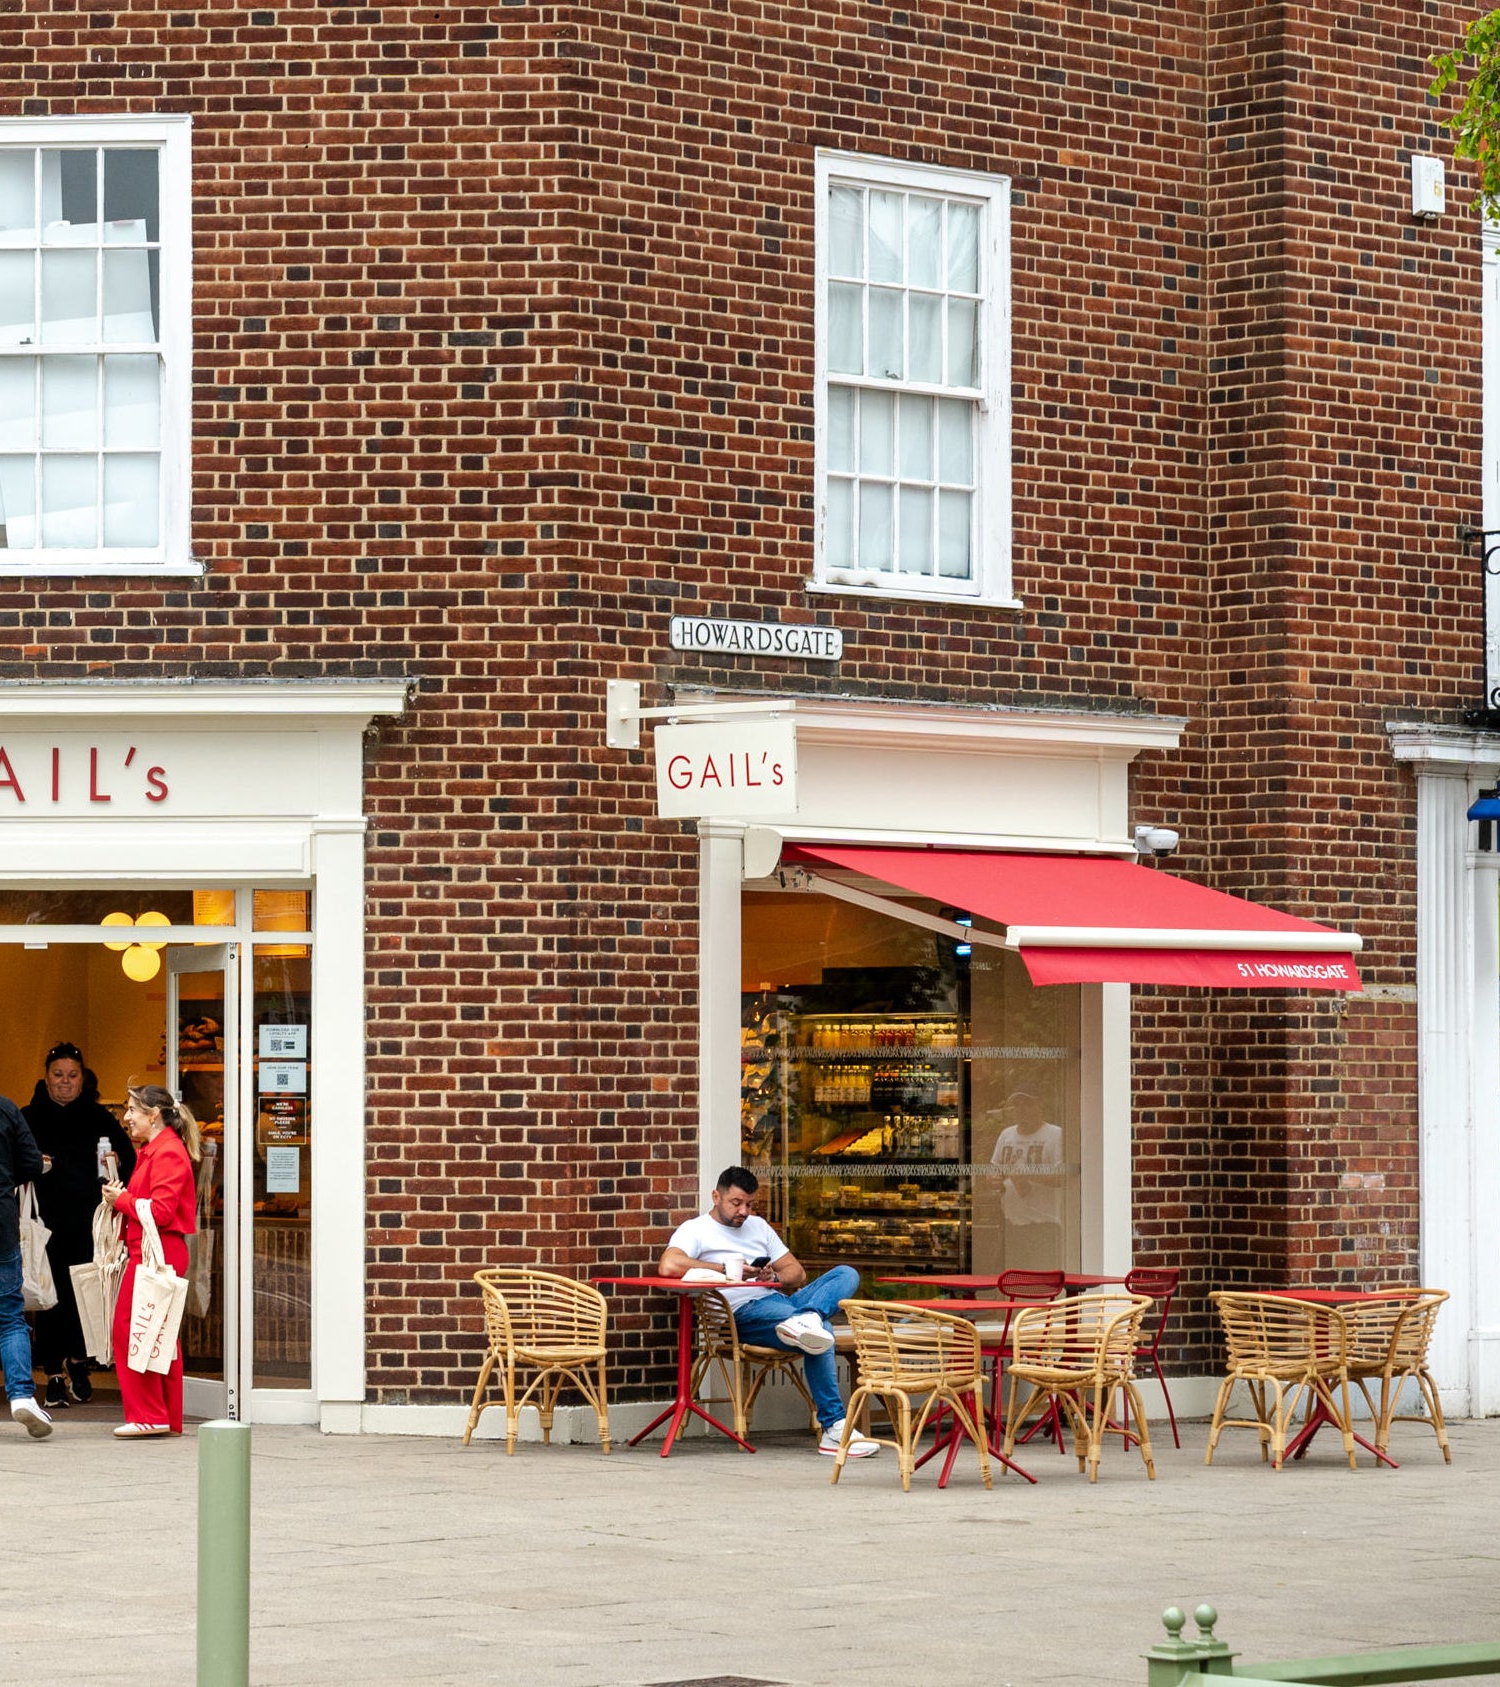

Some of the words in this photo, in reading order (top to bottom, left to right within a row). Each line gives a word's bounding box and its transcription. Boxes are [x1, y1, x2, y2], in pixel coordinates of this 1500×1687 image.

[680, 621, 835, 656] HOWARDSGATE
[668, 751, 784, 790] GAIL's
[1237, 963, 1255, 977] 51
[1254, 963, 1349, 979] HOWARDSGATE
